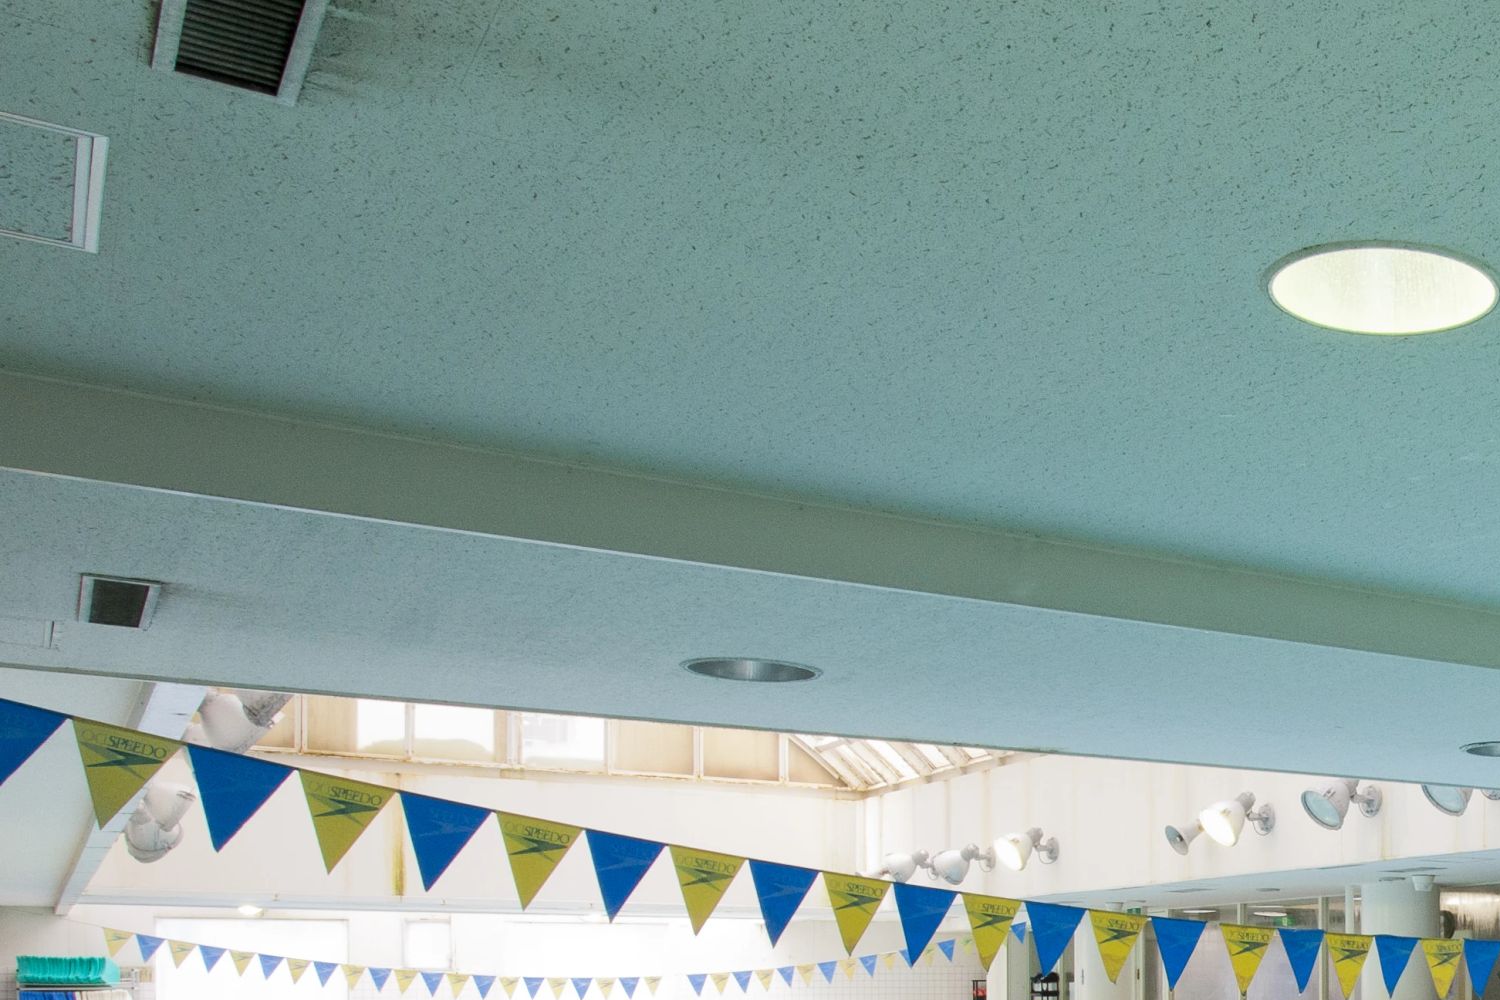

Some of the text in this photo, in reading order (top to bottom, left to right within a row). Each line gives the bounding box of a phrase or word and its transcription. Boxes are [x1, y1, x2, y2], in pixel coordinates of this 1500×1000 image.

[108, 735, 167, 759] SPEEDO
[330, 786, 382, 807] SPEEDO
[525, 825, 570, 845] SPEEDO
[695, 858, 737, 874] SPEEDO
[847, 882, 883, 897] SPEEDO
[982, 903, 1016, 916] SPEEDO
